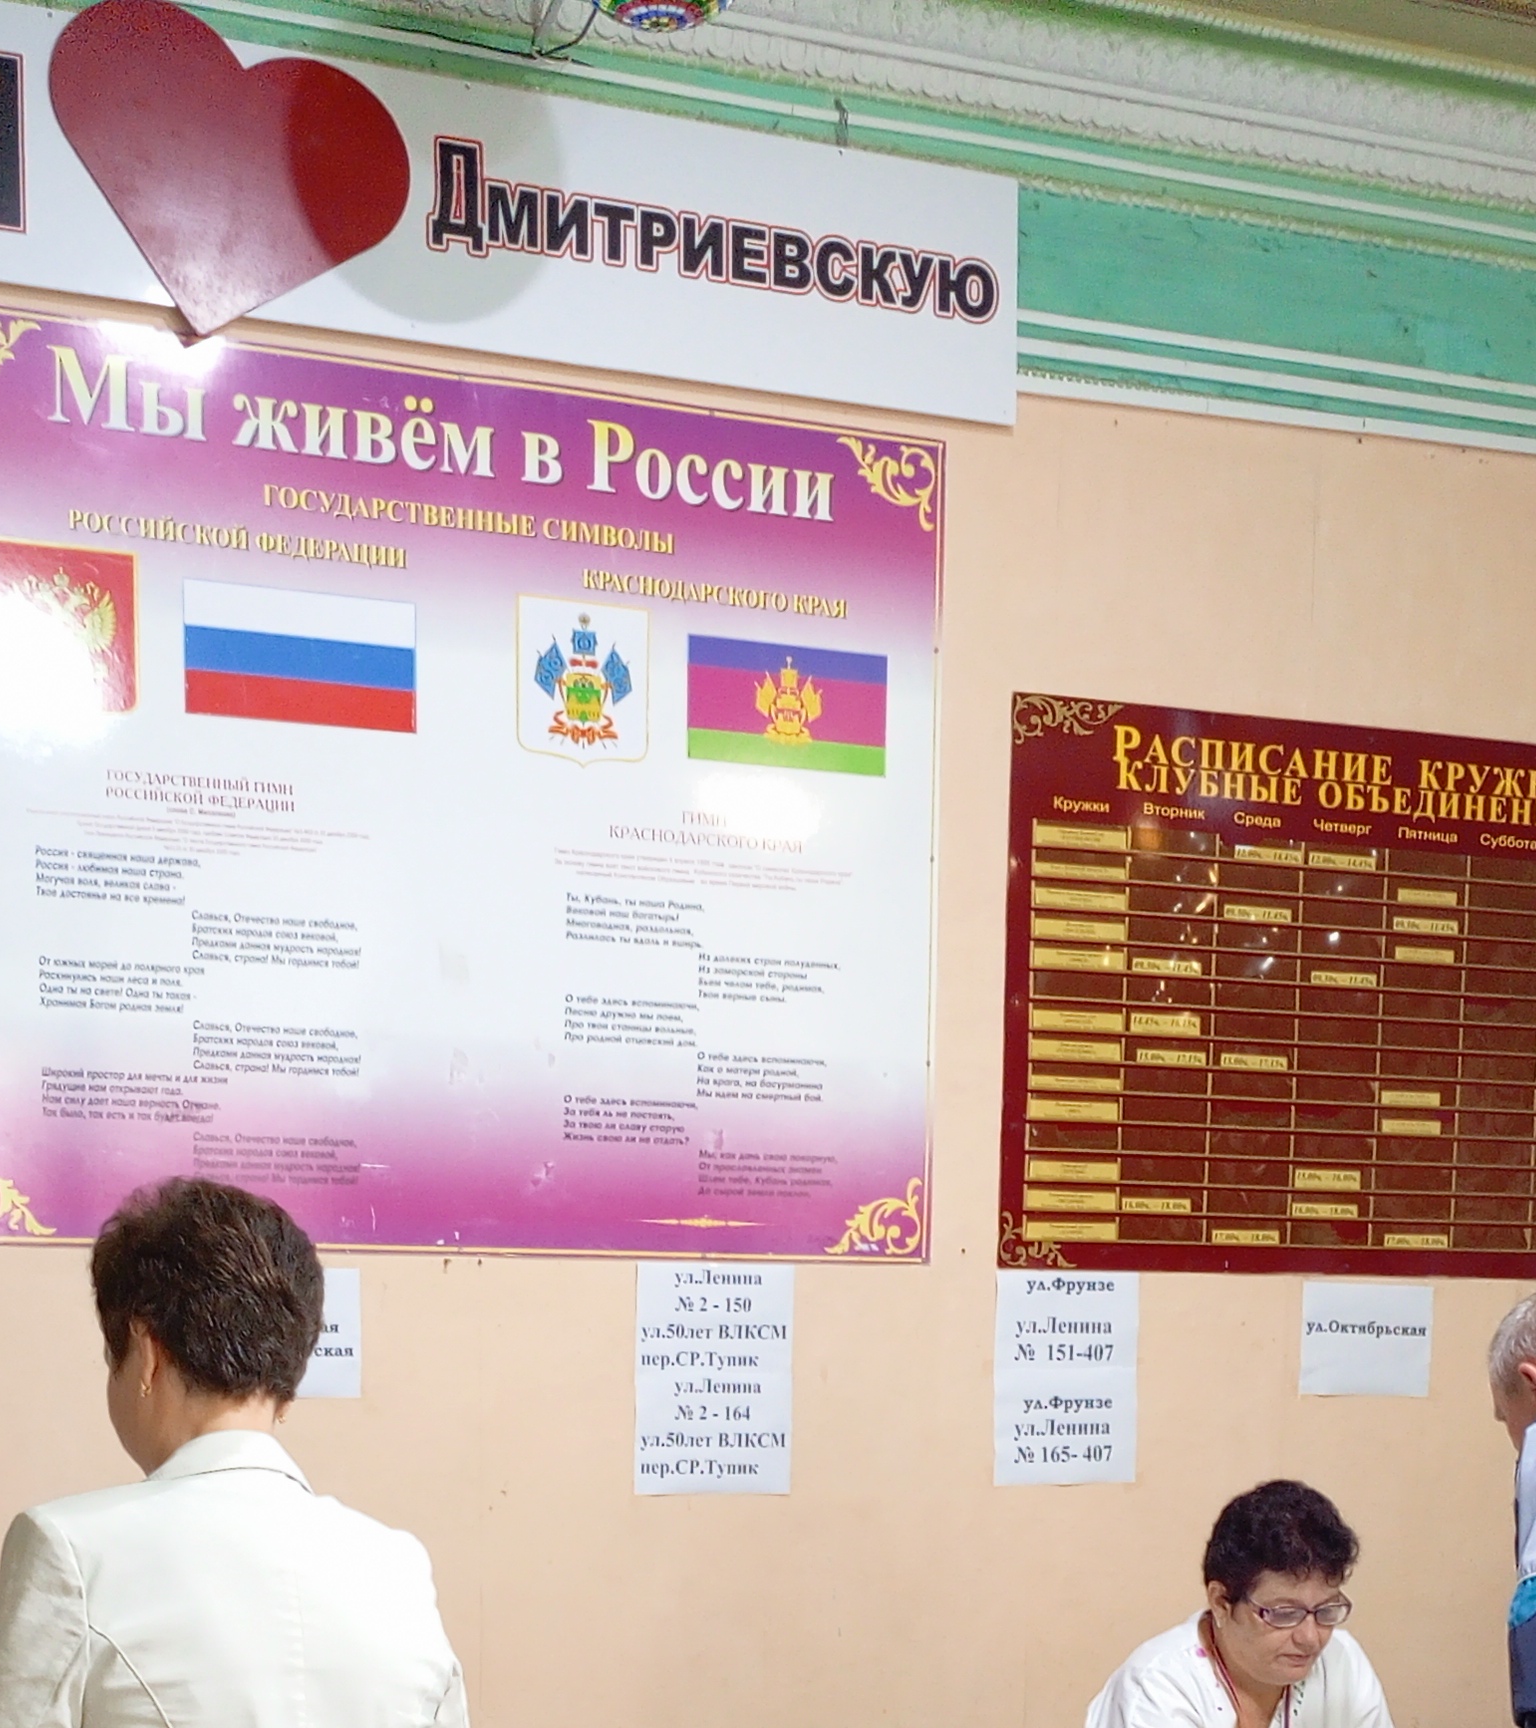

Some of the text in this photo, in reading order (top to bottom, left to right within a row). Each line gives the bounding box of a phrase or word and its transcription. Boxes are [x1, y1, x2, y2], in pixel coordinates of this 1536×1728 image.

[48, 345, 836, 523] Мы живём в России
[263, 484, 675, 556] ГОСУДАРСТВЕННЫЕ СИМВОЛЫ
[69, 508, 407, 570] РОССИЙСКОЙ ФЕДЕРАЦИИ
[583, 569, 848, 620] КРАСНОДАРСКОГО КРАЯ
[1114, 725, 1392, 786] РАСПИСАНИЕ
[107, 769, 293, 796] ГОСУДАРСТВЕННЫЙ ГИМН
[1116, 760, 1302, 805] КЛУБНЫЕ
[106, 787, 295, 812] РОССИЙСКОЙ ФЕДЕРАЦИИ
[1053, 796, 1110, 813] Кружки
[1144, 802, 1205, 820] Вторник
[1234, 812, 1281, 828] Среда
[1313, 818, 1372, 837] Четверг
[1398, 827, 1457, 843] Пятница
[609, 825, 803, 854] КРАСНОДАРСКОГО КРАЯ
[674, 1270, 762, 1289] ул.Ленина
[1026, 1277, 1115, 1294] ул.Фрунзе
[675, 1297, 695, 1313] №
[699, 1297, 709, 1312] 2
[725, 1298, 752, 1313] 150
[641, 1323, 787, 1342] ул.50лет ВЛКСМ
[1015, 1318, 1112, 1337] ул.Ленина
[1306, 1321, 1427, 1339] ул.Октябрьская
[641, 1351, 759, 1371] пер.СР.Тупик
[1014, 1344, 1114, 1361] № 151-407
[674, 1379, 761, 1397] ул.Ленина
[675, 1405, 695, 1422] №
[699, 1406, 709, 1421] 2
[725, 1406, 751, 1421] 164
[1024, 1395, 1112, 1413] ул.Фрунзе
[1014, 1420, 1110, 1438] ул.Ленина
[641, 1432, 786, 1450] ул.50лет ВЛКСМ
[1014, 1446, 1035, 1464] №
[1083, 1445, 1112, 1463] 407
[641, 1460, 759, 1479] пер.СР.Тупик
